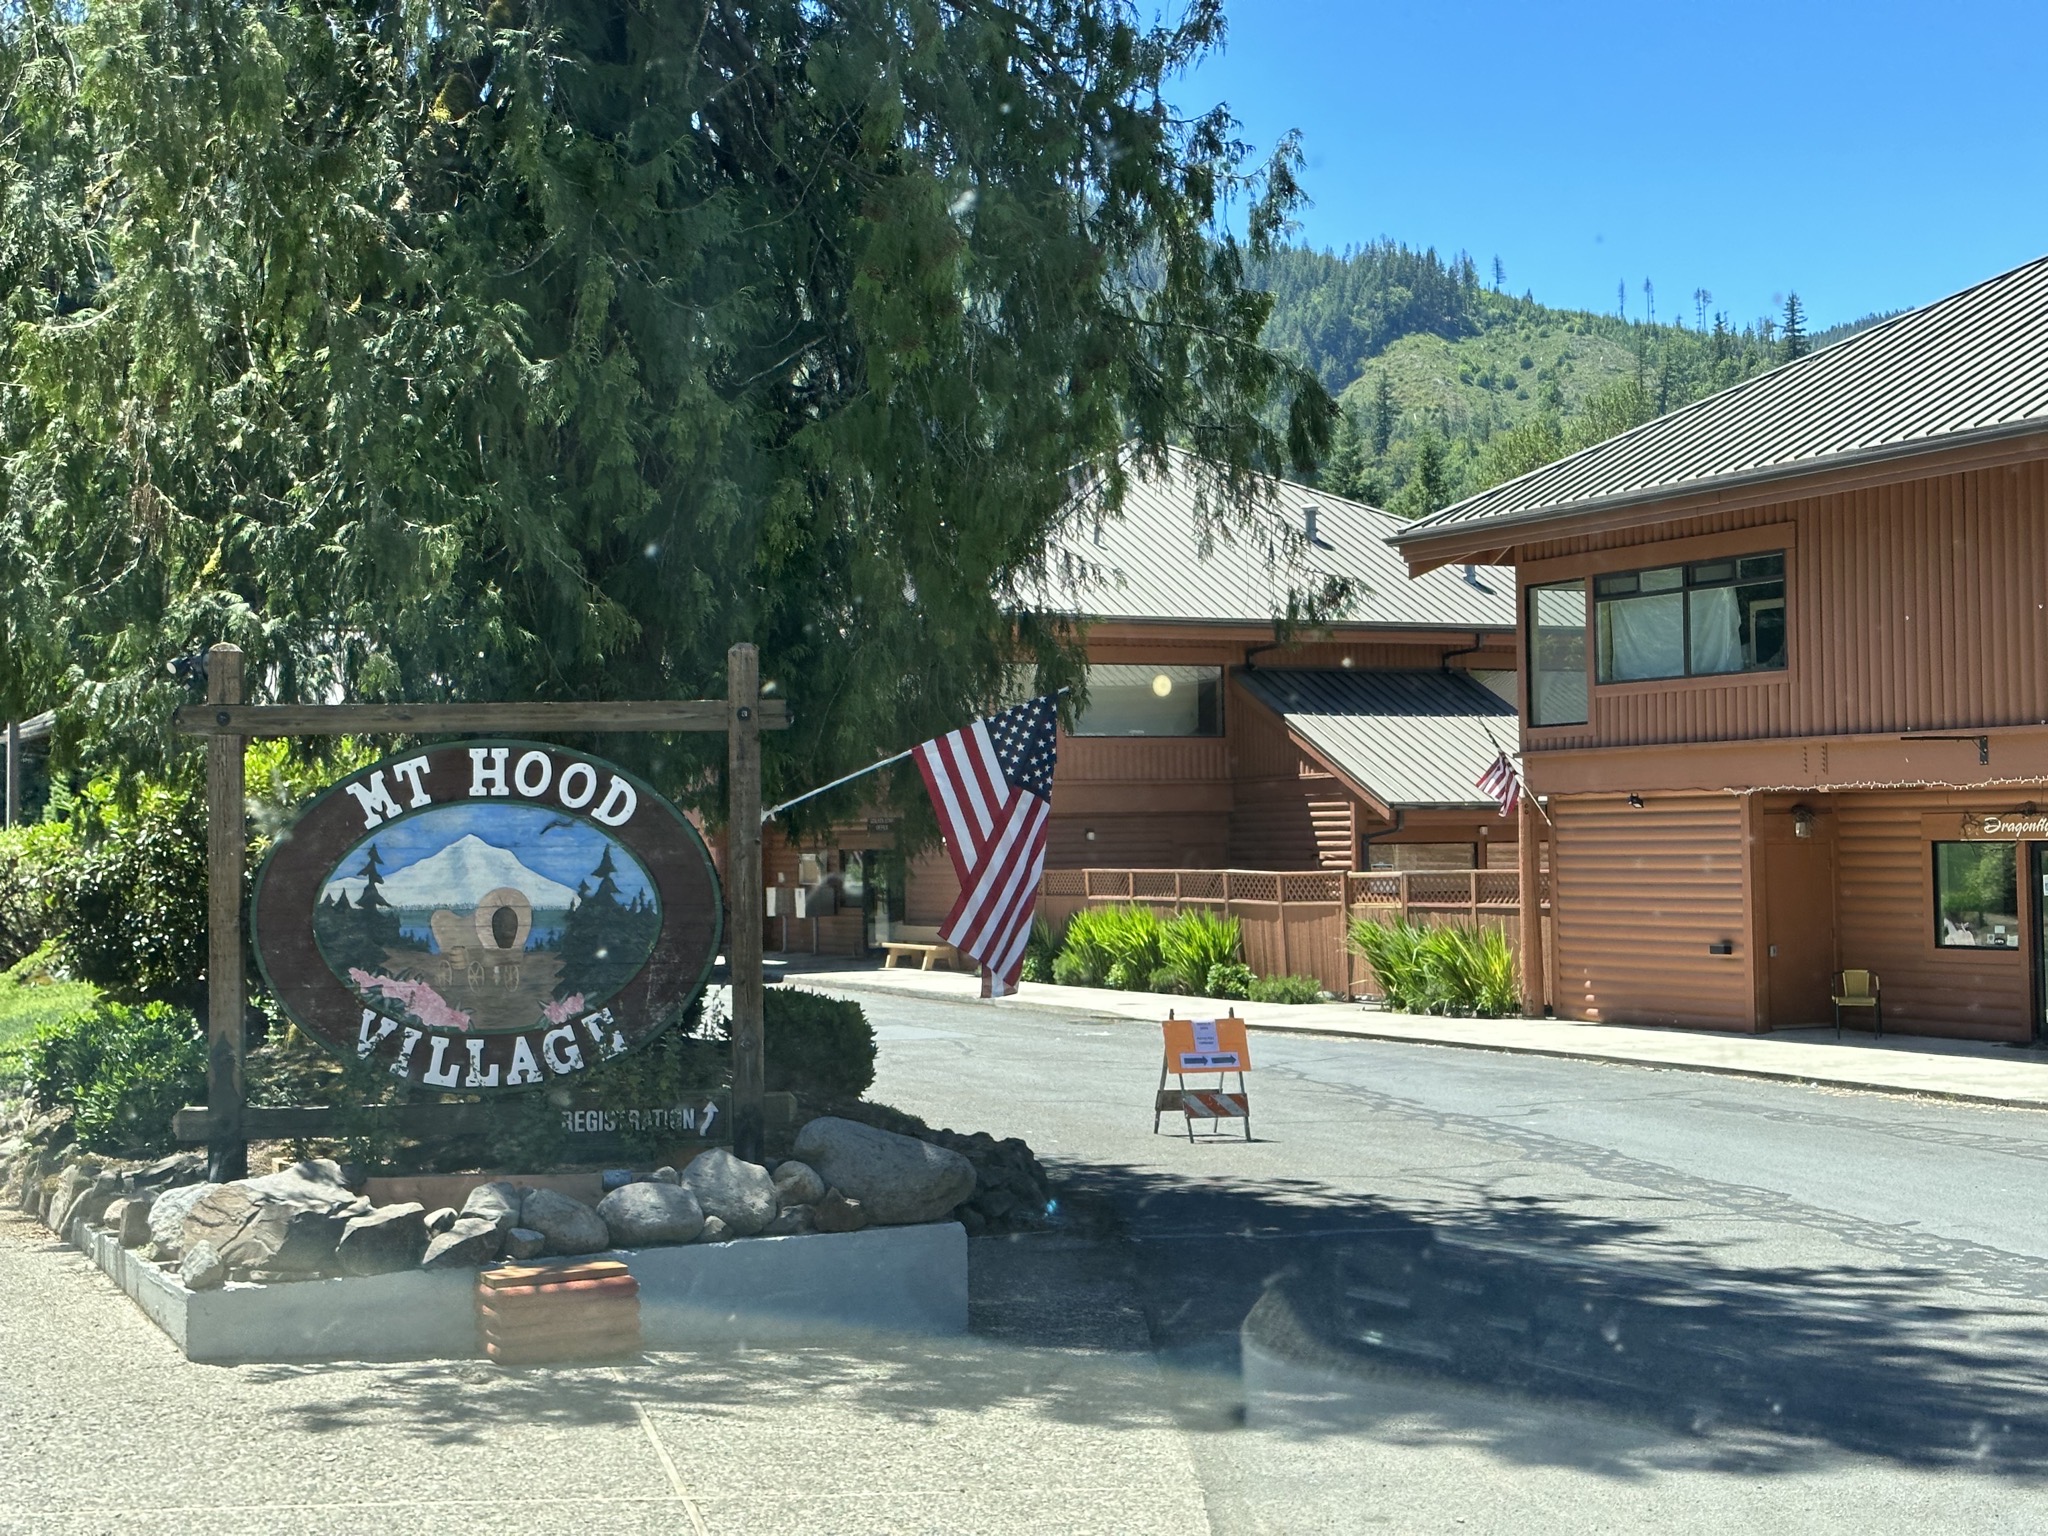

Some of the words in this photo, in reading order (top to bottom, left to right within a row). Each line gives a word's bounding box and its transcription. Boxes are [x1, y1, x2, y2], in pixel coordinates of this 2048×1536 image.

[345, 755, 433, 831] MT
[468, 747, 638, 828] HOOD
[356, 1007, 629, 1088] VILLAGE
[561, 1108, 695, 1132] REGISRTION
